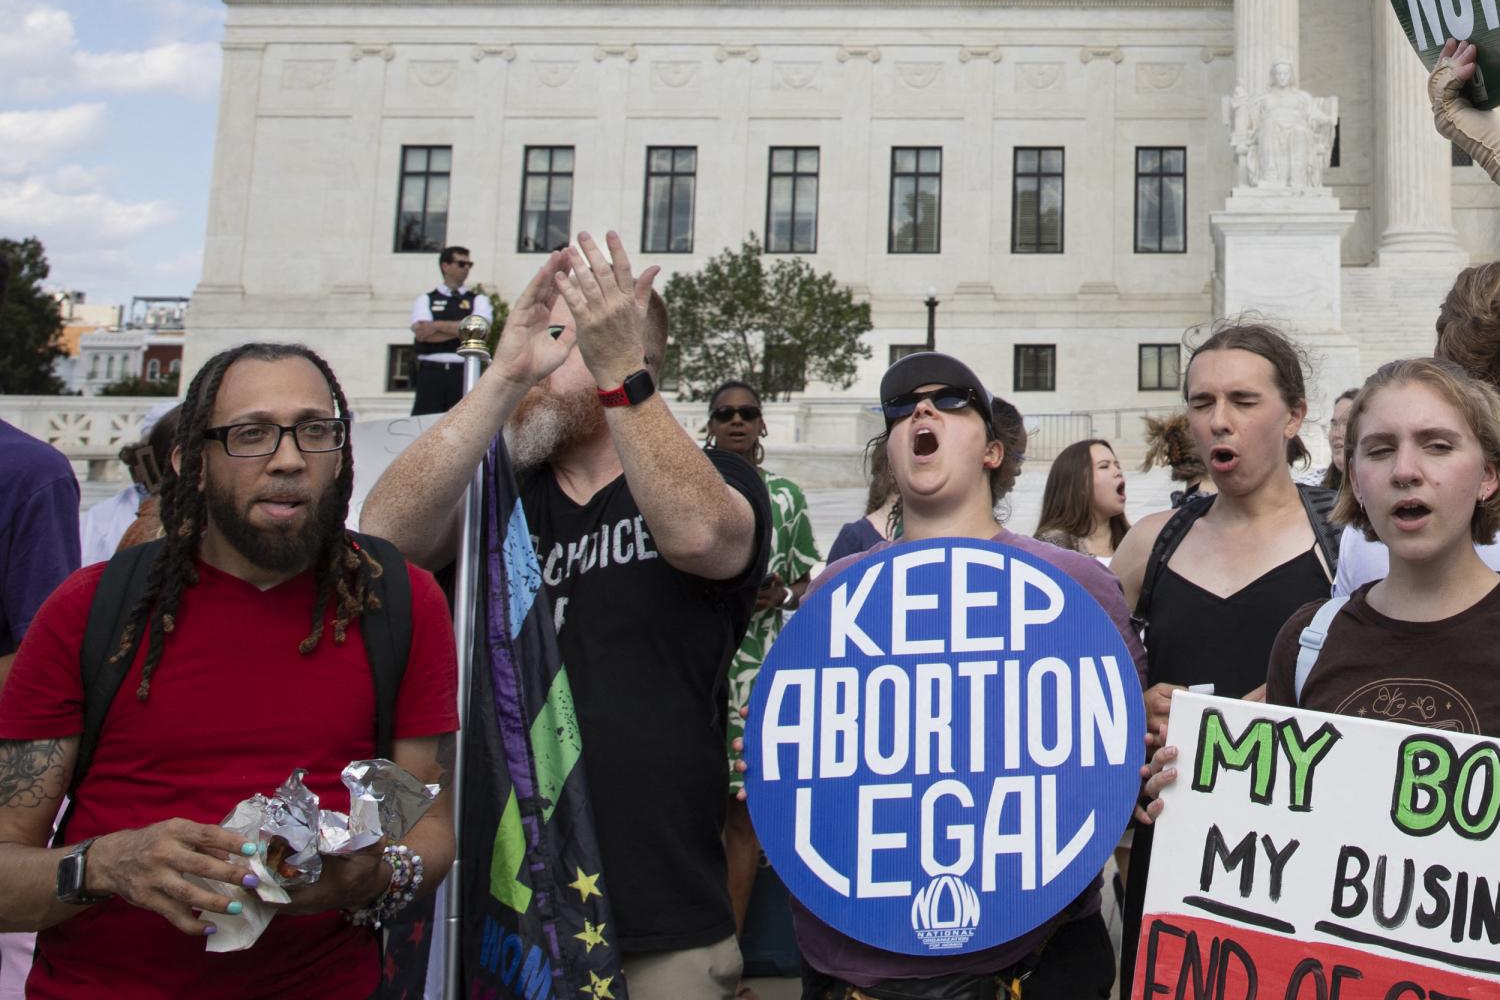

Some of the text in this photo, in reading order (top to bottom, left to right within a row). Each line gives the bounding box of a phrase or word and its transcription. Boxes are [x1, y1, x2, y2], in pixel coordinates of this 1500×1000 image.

[829, 547, 1065, 658] KEEP
[762, 656, 1128, 781] ABORTION
[1191, 707, 1343, 812] MY
[795, 774, 1095, 899] LEGAL
[1200, 824, 1300, 903] MY
[911, 875, 981, 931] NOW
[917, 929, 974, 938] NATIONAL
